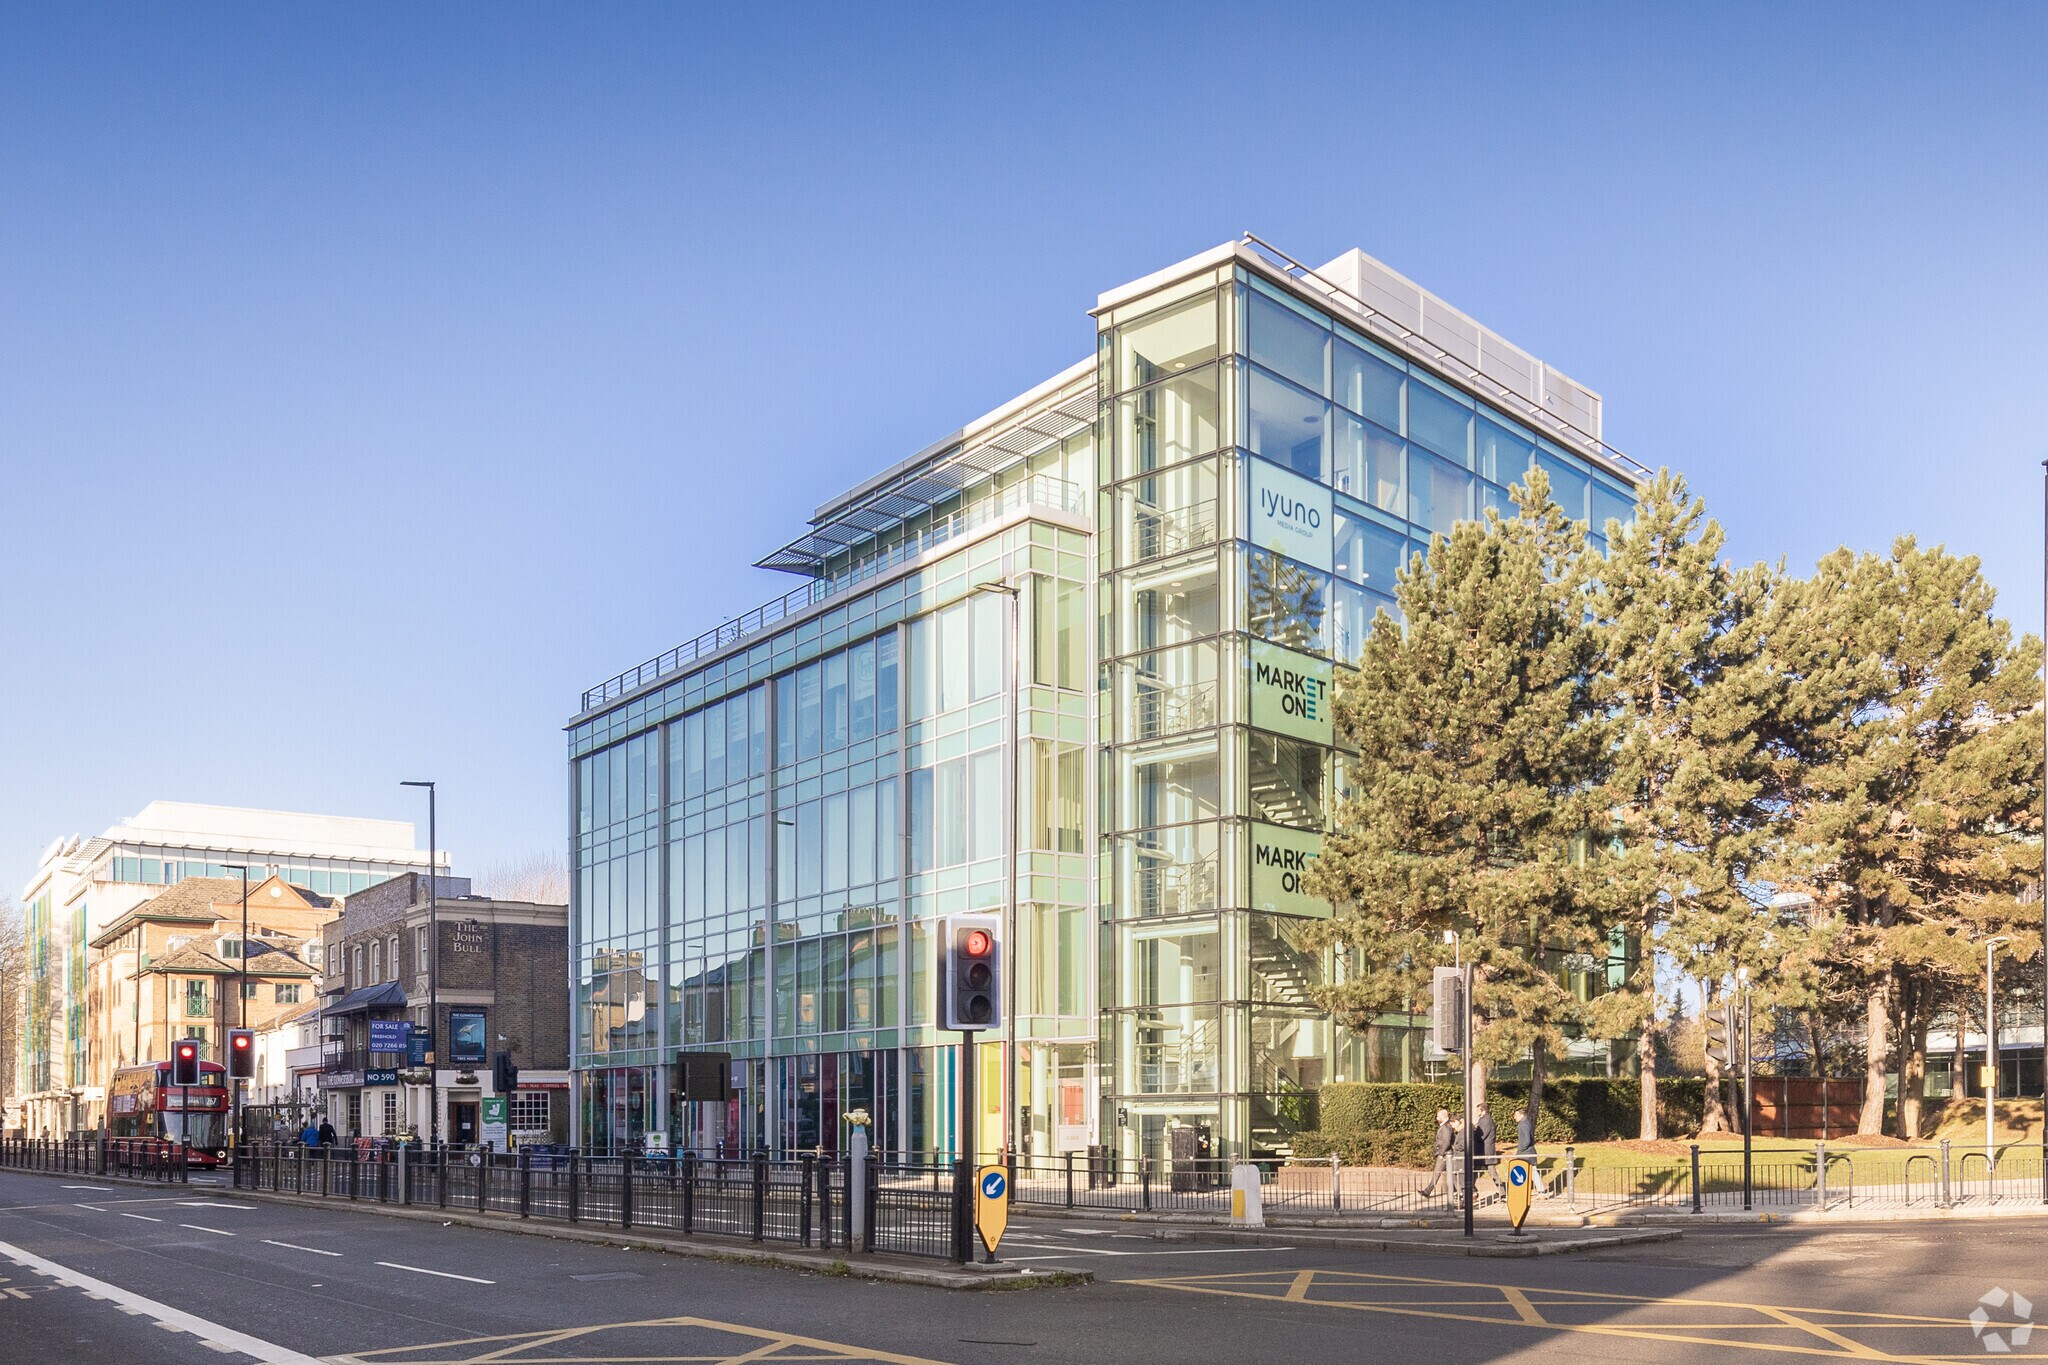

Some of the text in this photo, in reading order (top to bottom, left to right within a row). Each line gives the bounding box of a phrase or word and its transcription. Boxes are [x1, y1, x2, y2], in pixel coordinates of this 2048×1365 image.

[1277, 519, 1314, 538] MEDIA GROUP
[1256, 661, 1327, 701] MARKET
[1256, 843, 1320, 872] MARK
[1281, 872, 1307, 895] ON
[455, 921, 478, 932] THE
[452, 931, 483, 943] JOHN
[453, 942, 482, 953] BULL
[367, 1073, 380, 1081] NO
[380, 1073, 396, 1081] 590
